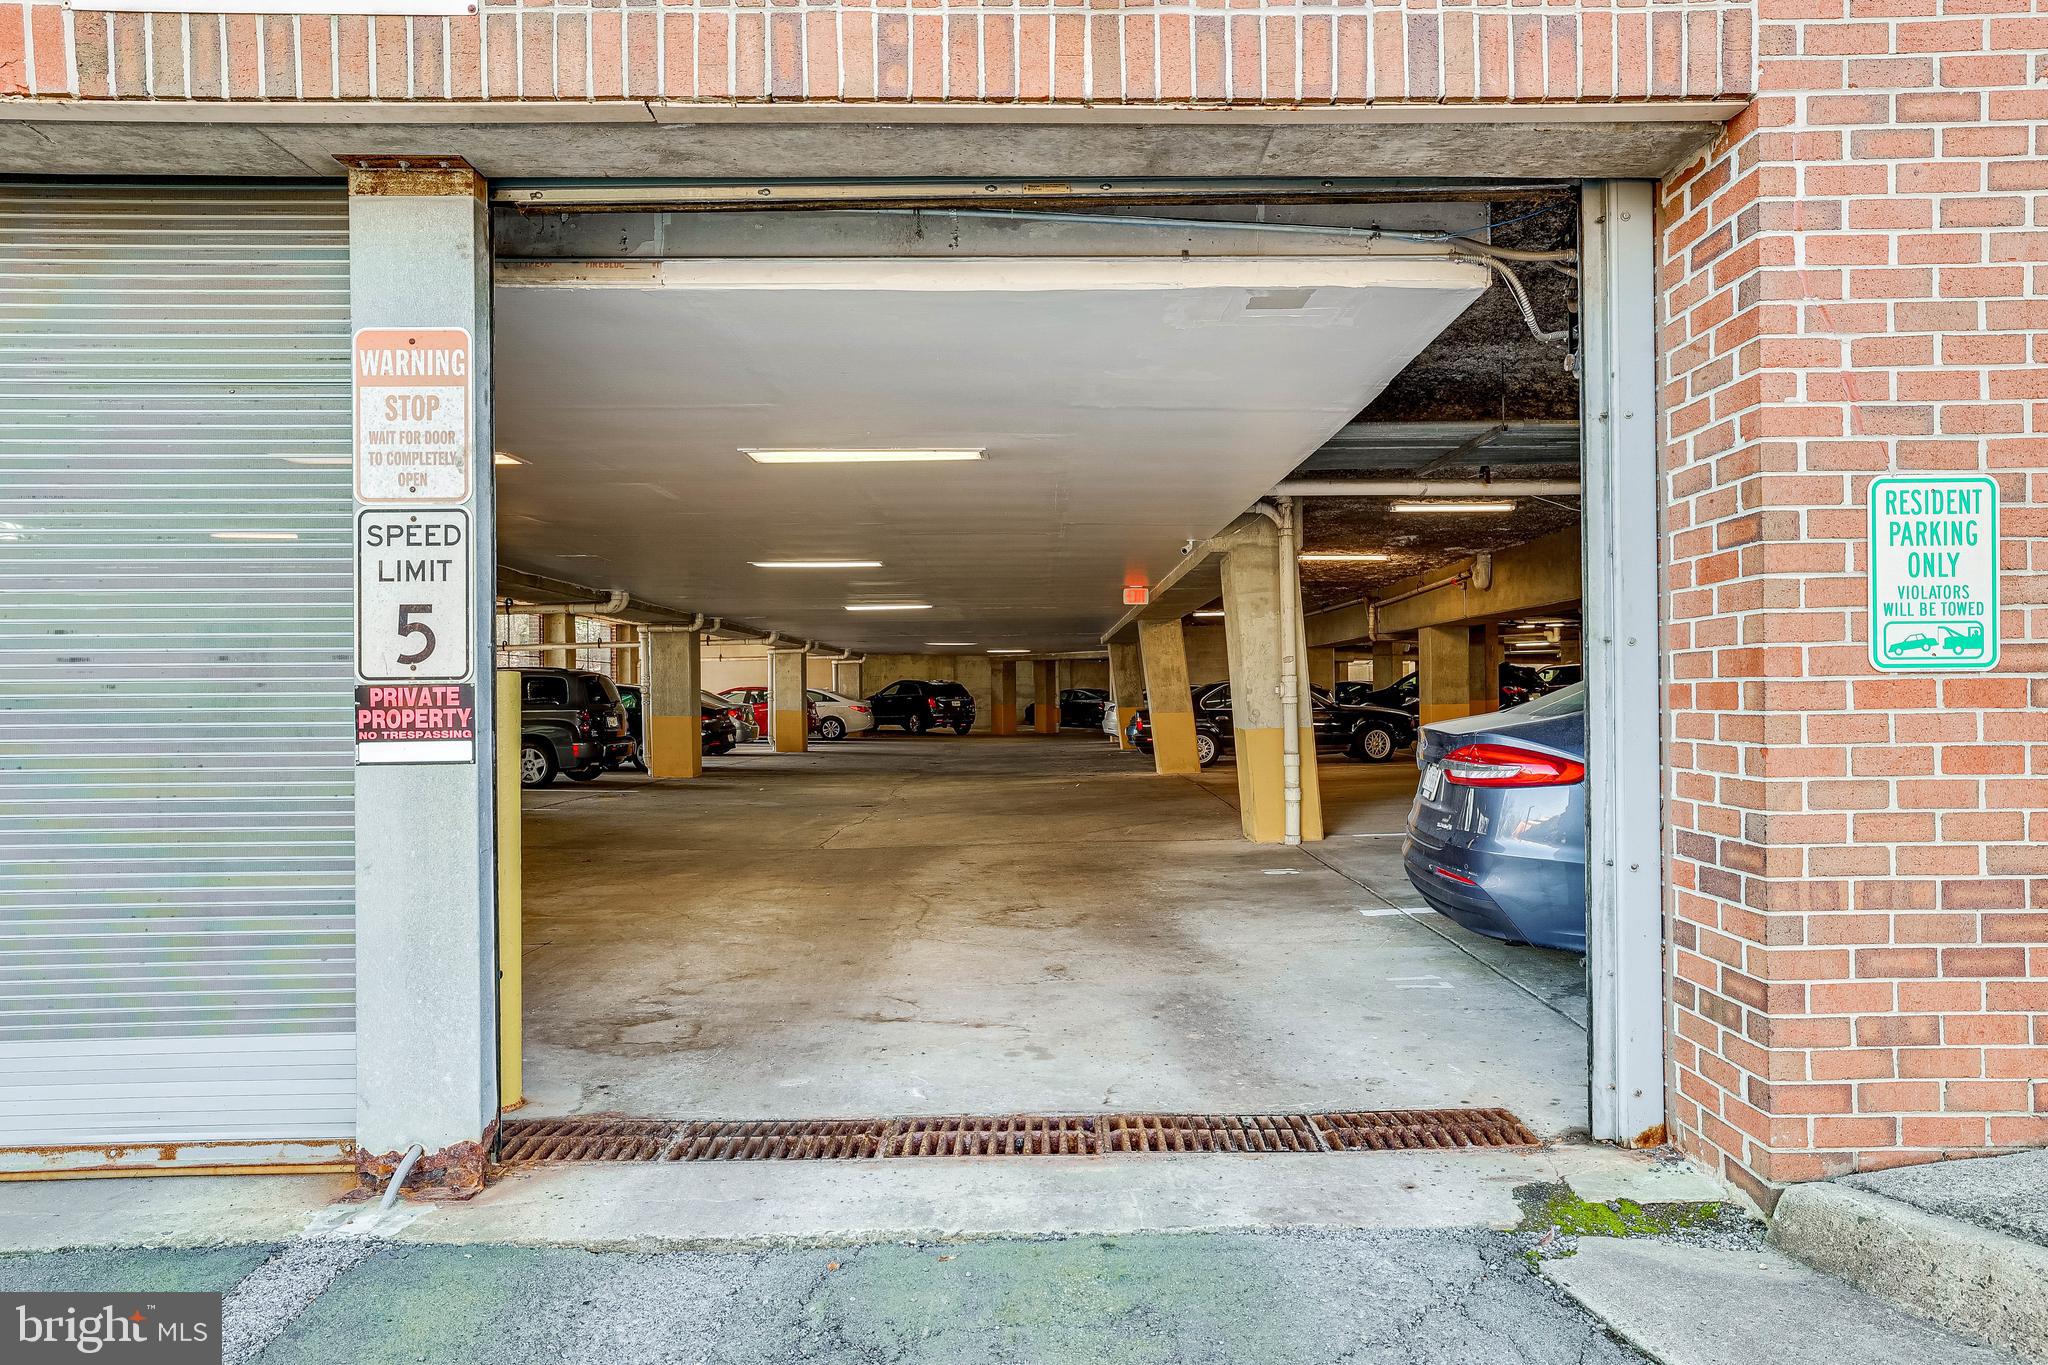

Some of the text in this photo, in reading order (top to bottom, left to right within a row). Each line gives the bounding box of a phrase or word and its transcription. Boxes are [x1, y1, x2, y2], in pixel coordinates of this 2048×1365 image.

[359, 349, 465, 377] WARNING
[384, 394, 440, 422] STOP
[368, 430, 456, 445] WAIT FOR DOOR
[368, 451, 457, 466] TO COMPLETELY
[397, 472, 428, 487] OPEN
[1885, 489, 1983, 516] RESIDENT
[366, 524, 462, 547] SPEED
[1889, 520, 1978, 547] PARKING
[378, 559, 453, 582] LIMIT
[1907, 551, 1960, 579] ONLY
[1897, 585, 1970, 600] VIOLATORS
[1883, 601, 1984, 617] WILL BE TOWED
[396, 604, 436, 665] 5
[369, 686, 460, 708] PRIVATE
[358, 708, 472, 729] PROPERTY
[358, 729, 472, 740] NO TRESPASSING
